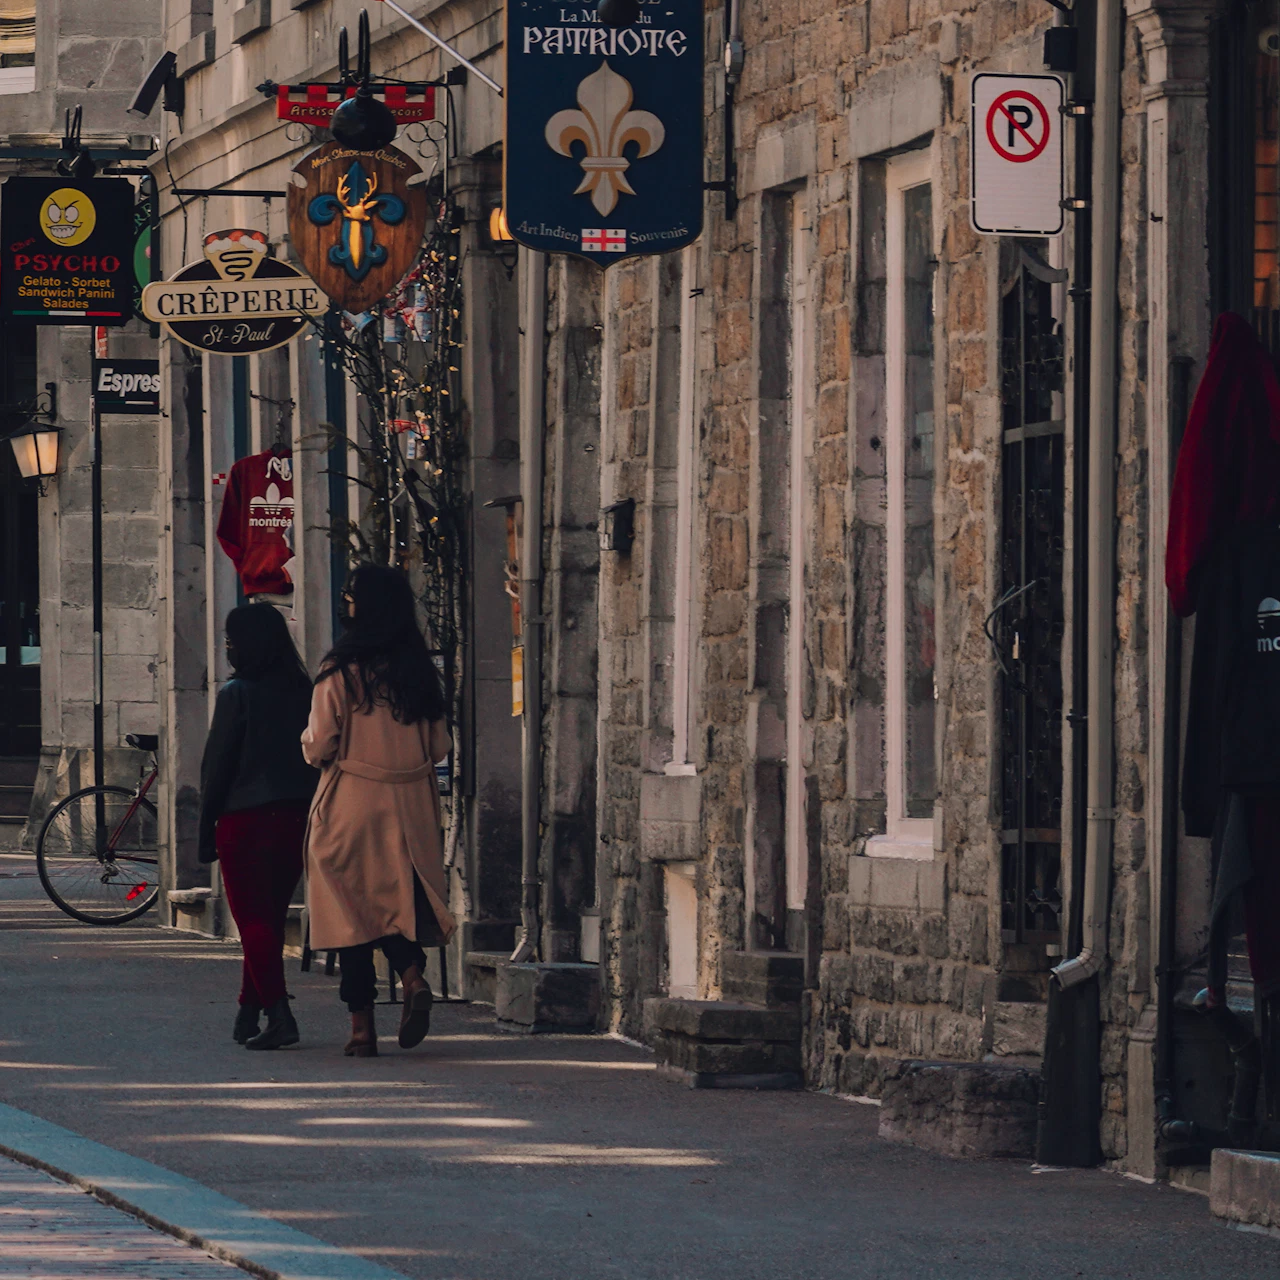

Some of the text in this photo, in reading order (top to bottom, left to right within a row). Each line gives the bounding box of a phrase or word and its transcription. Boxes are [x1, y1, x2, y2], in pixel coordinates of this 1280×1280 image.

[560, 9, 578, 22] La
[635, 11, 652, 24] du
[523, 26, 688, 57] PATRIOTE
[516, 220, 689, 245] Art Indien Souvenirs
[13, 253, 121, 273] PSYCHO
[17, 286, 115, 299] Sandwich Panini
[23, 275, 61, 286] Gelato
[72, 276, 111, 288] Sorbet
[42, 298, 89, 309] Salades
[157, 285, 319, 316] CRÊPERIE
[203, 322, 276, 346] St-Paul
[97, 367, 161, 398] Espres
